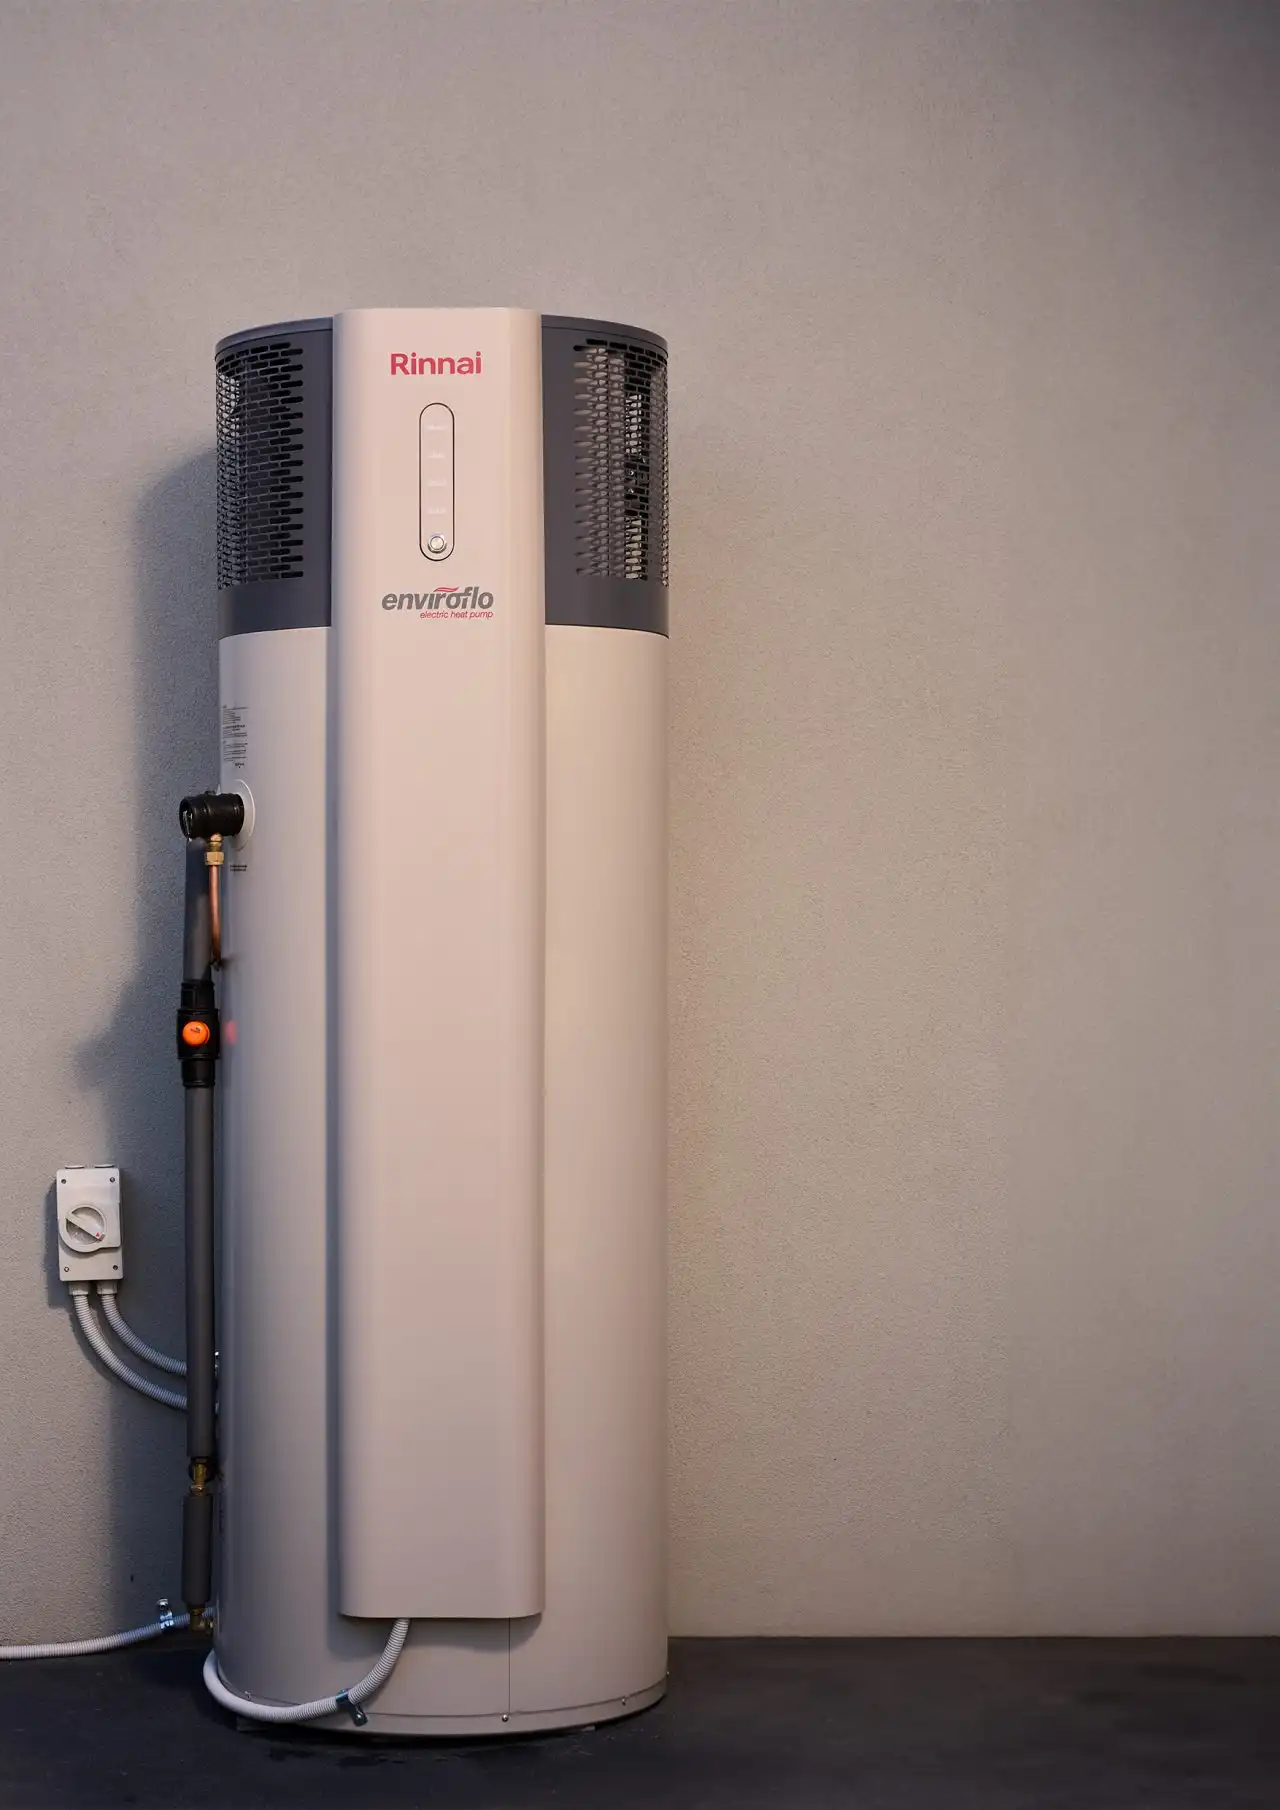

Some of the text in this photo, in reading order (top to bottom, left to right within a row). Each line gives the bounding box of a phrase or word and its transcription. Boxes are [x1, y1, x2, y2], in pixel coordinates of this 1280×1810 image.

[390, 351, 482, 375] Rinnai
[381, 586, 494, 610] enviroflo
[420, 611, 494, 619] electric heat pump
